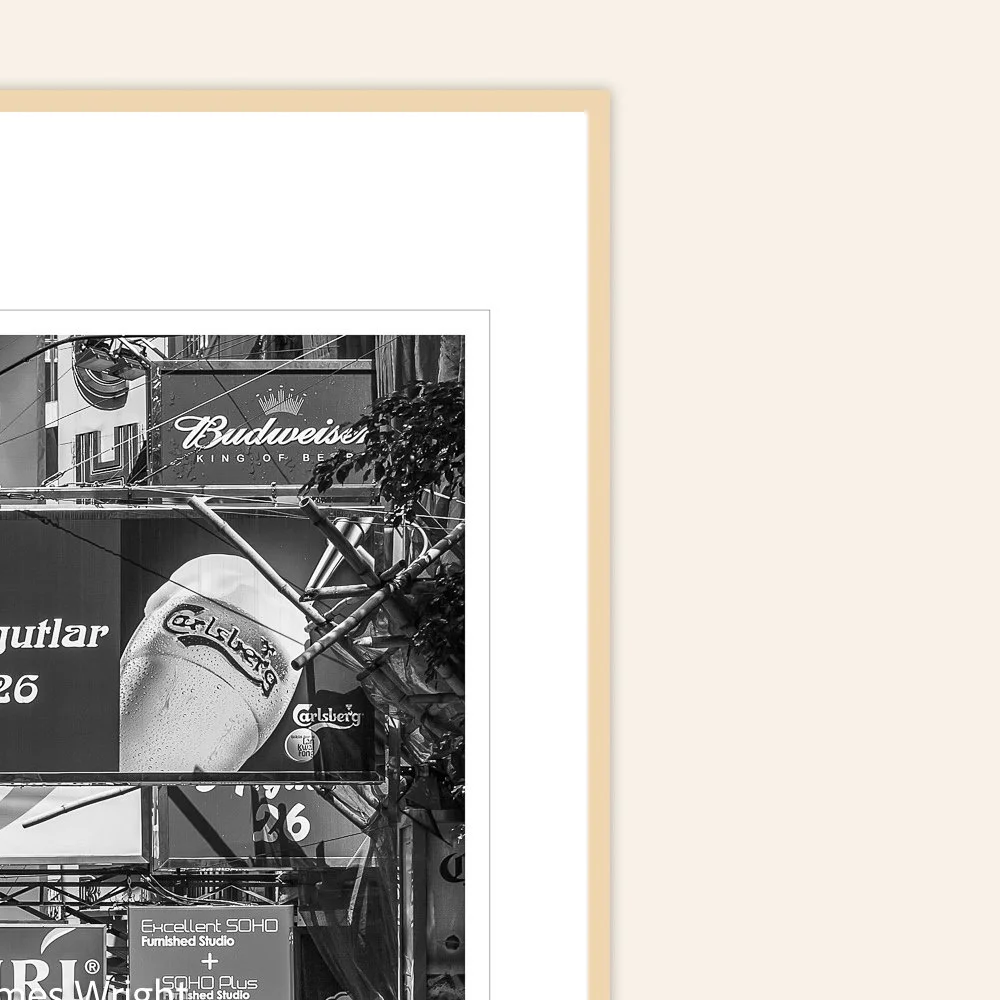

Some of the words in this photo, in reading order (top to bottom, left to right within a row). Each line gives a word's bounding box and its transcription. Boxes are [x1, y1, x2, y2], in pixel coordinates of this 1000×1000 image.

[197, 454, 245, 463] KING
[263, 454, 287, 463] OF
[162, 604, 278, 699] Carlsberg
[292, 703, 362, 728] Carlsberg
[253, 803, 311, 842] 26
[141, 919, 221, 933] Excellent
[226, 919, 279, 933] SOHO
[141, 935, 196, 947] Furnished
[199, 935, 235, 947] Studio
[162, 976, 214, 990] SOHO
[219, 976, 258, 990] Plus
[216, 990, 250, 1000] Studio
